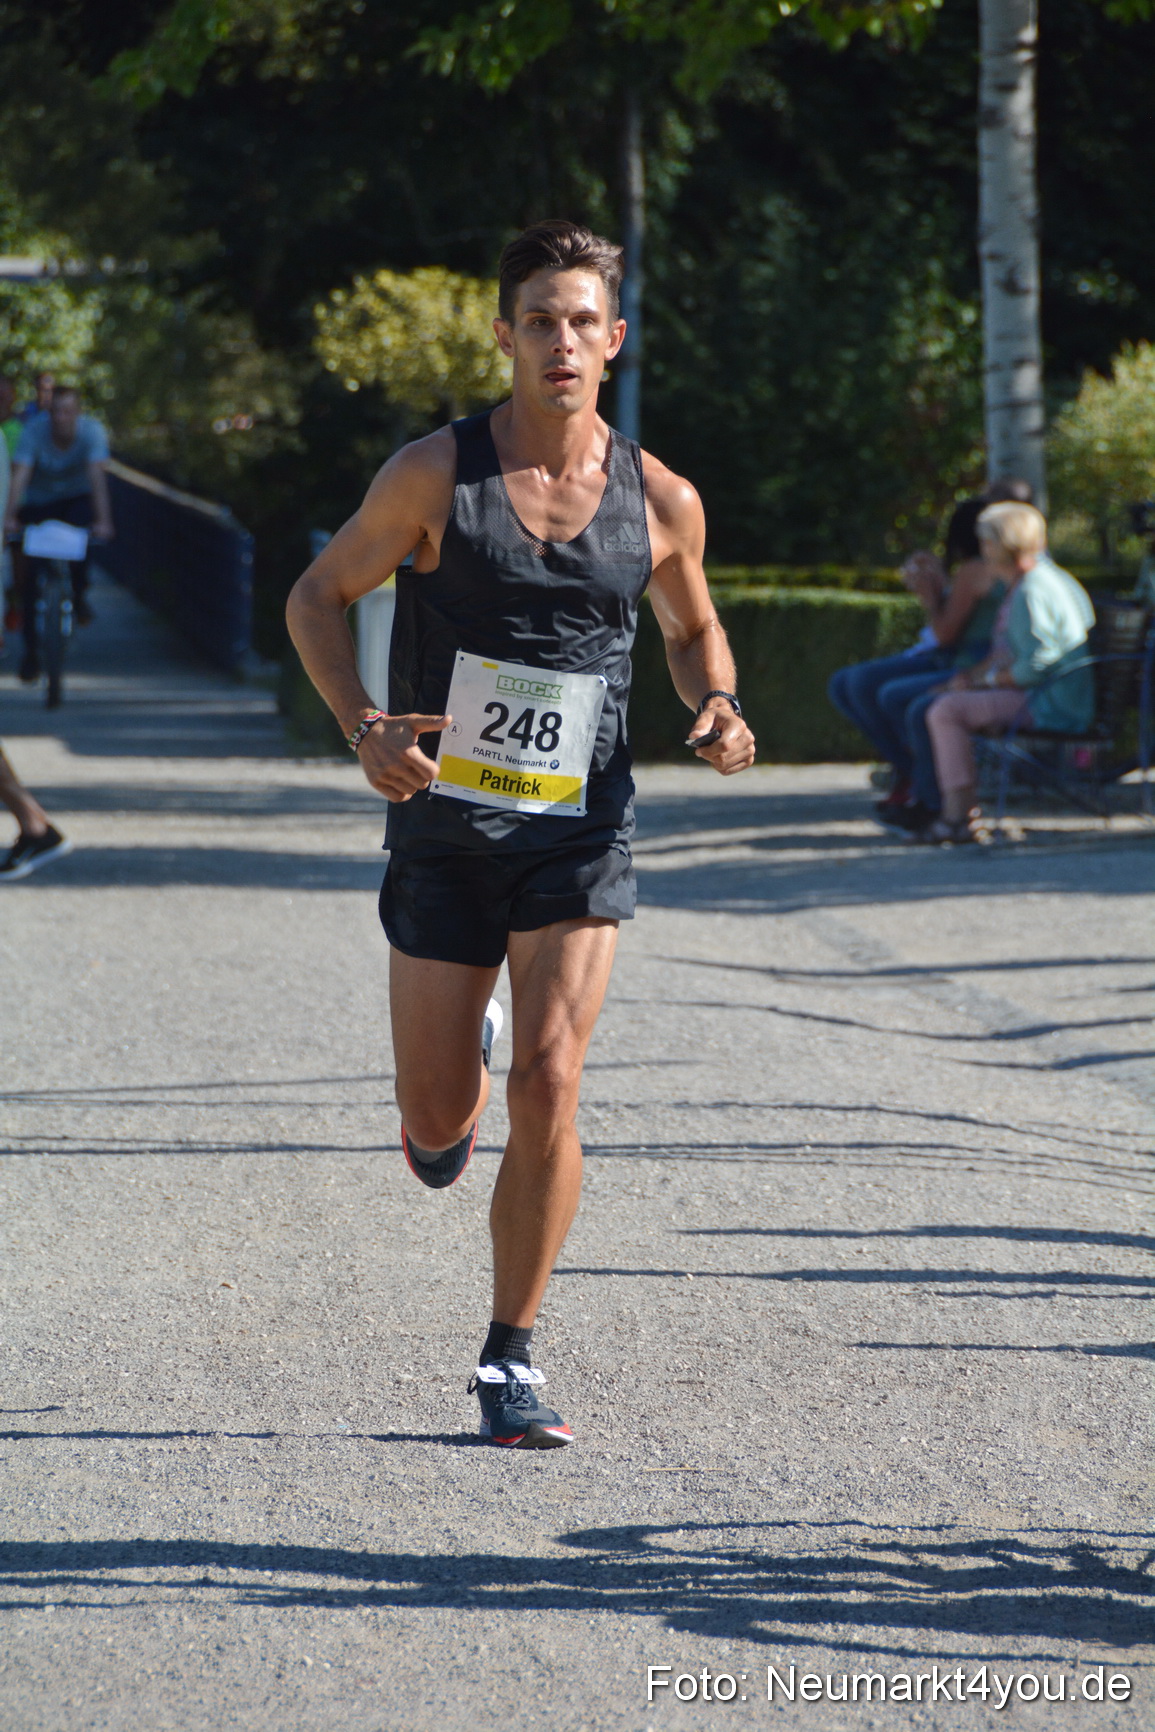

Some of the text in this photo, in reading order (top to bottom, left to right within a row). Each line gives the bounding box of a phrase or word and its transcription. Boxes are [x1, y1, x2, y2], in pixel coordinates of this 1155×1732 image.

[496, 674, 563, 699] BOCK
[451, 725, 458, 734] A
[479, 701, 563, 752] 248
[472, 746, 547, 768] PARTL Neumarkt
[479, 768, 542, 796] Patrick
